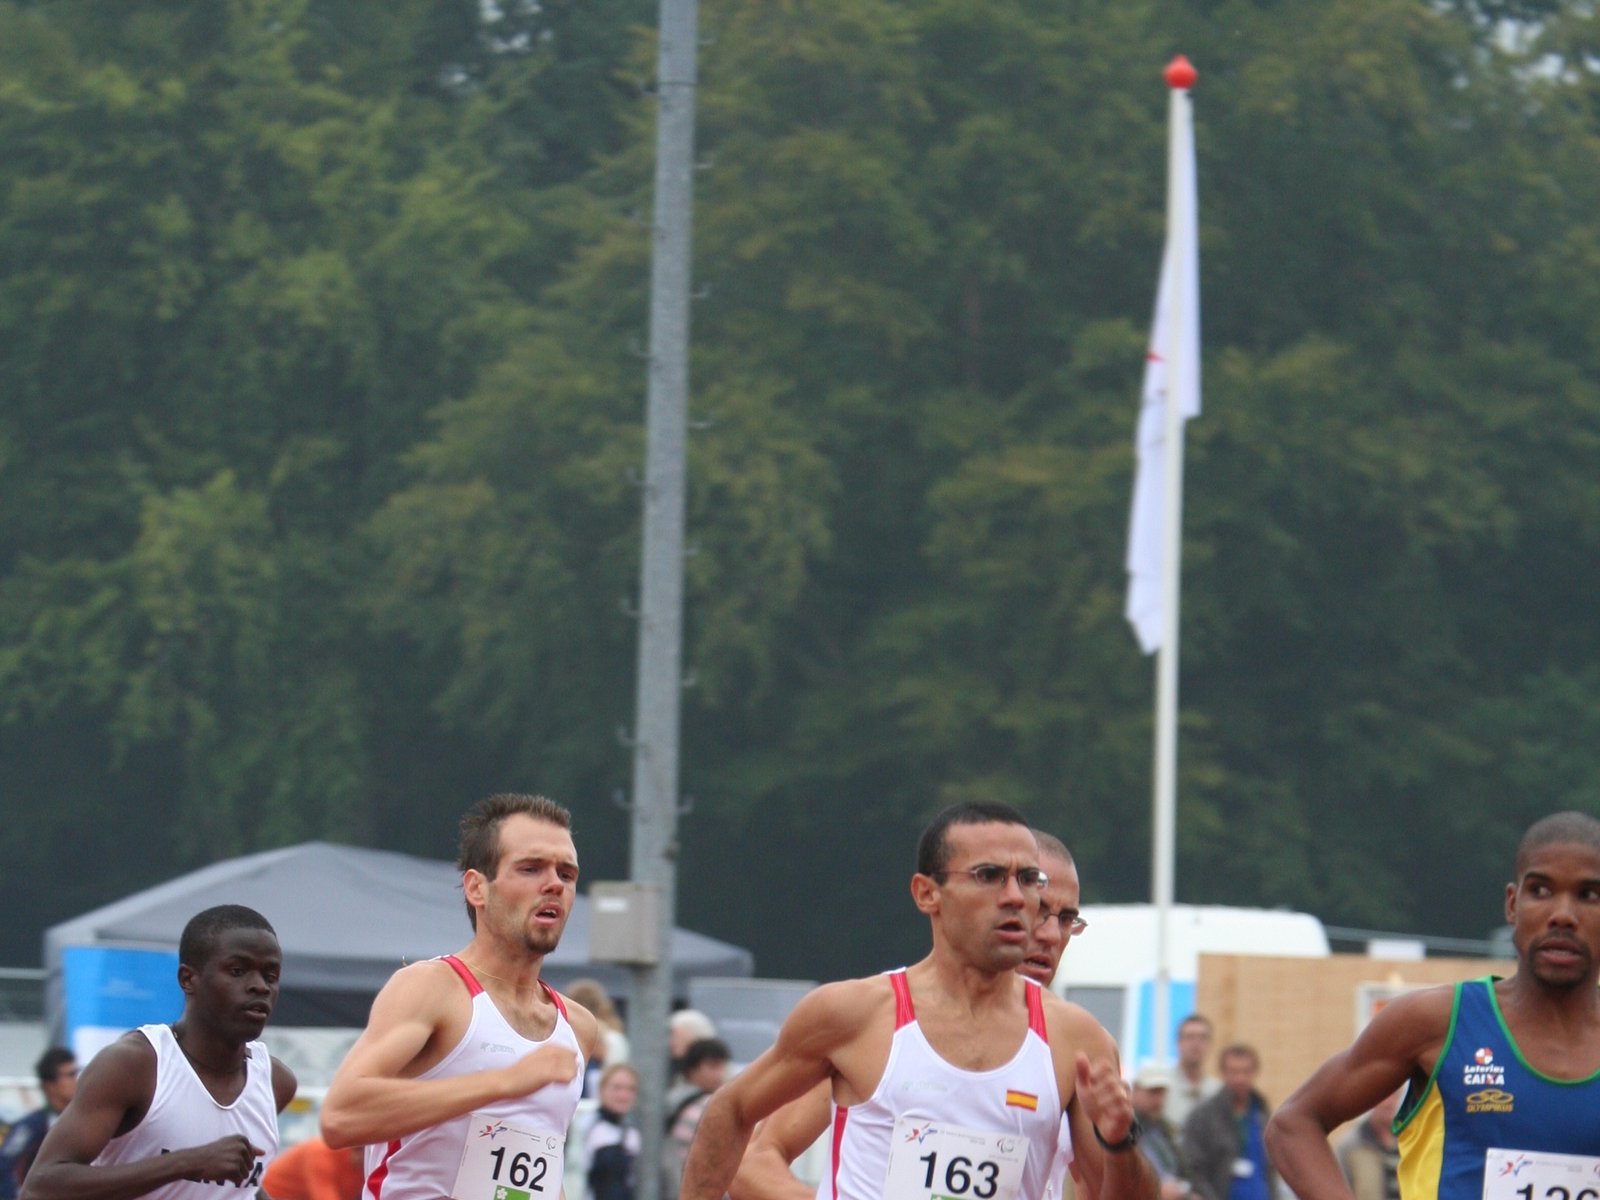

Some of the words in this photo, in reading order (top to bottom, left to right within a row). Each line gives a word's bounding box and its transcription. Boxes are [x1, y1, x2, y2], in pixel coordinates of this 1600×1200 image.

[1464, 1074, 1505, 1085] CAIXA
[490, 1146, 548, 1192] 162
[920, 1151, 1000, 1199] 163
